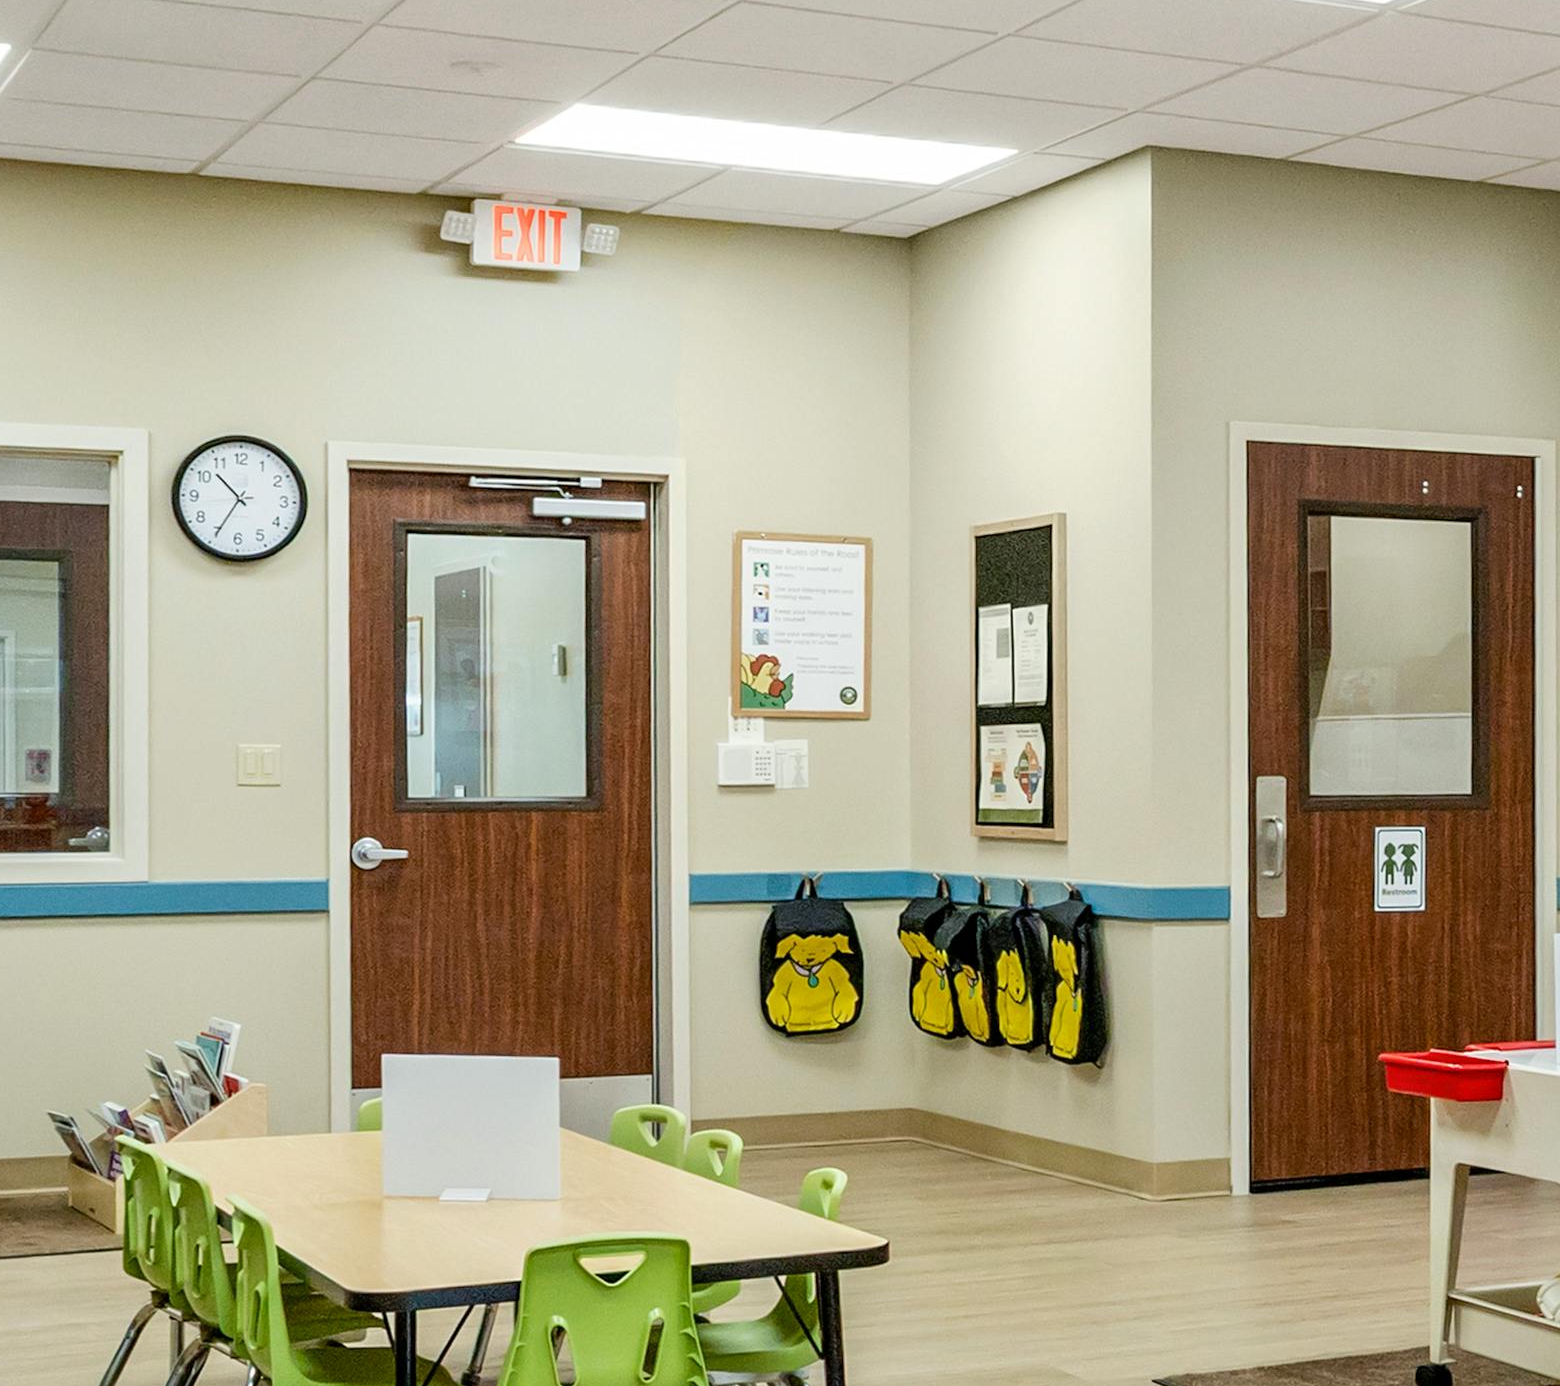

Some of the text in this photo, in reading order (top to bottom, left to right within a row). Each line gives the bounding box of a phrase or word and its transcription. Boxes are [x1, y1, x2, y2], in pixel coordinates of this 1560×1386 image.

[492, 204, 569, 266] EXIT
[213, 456, 227, 469] 11
[234, 452, 249, 465] 12
[259, 460, 266, 472] 1
[197, 469, 212, 483] 10
[272, 474, 283, 488] 2
[188, 489, 199, 502] 9
[279, 495, 290, 509] 3
[195, 510, 206, 524] 8
[271, 515, 281, 528] 4
[232, 532, 244, 546] 6
[255, 528, 266, 542] 5
[786, 547, 809, 556] Rules
[809, 548, 819, 556] of
[820, 549, 835, 557] the
[1381, 888, 1418, 896] Restroom
